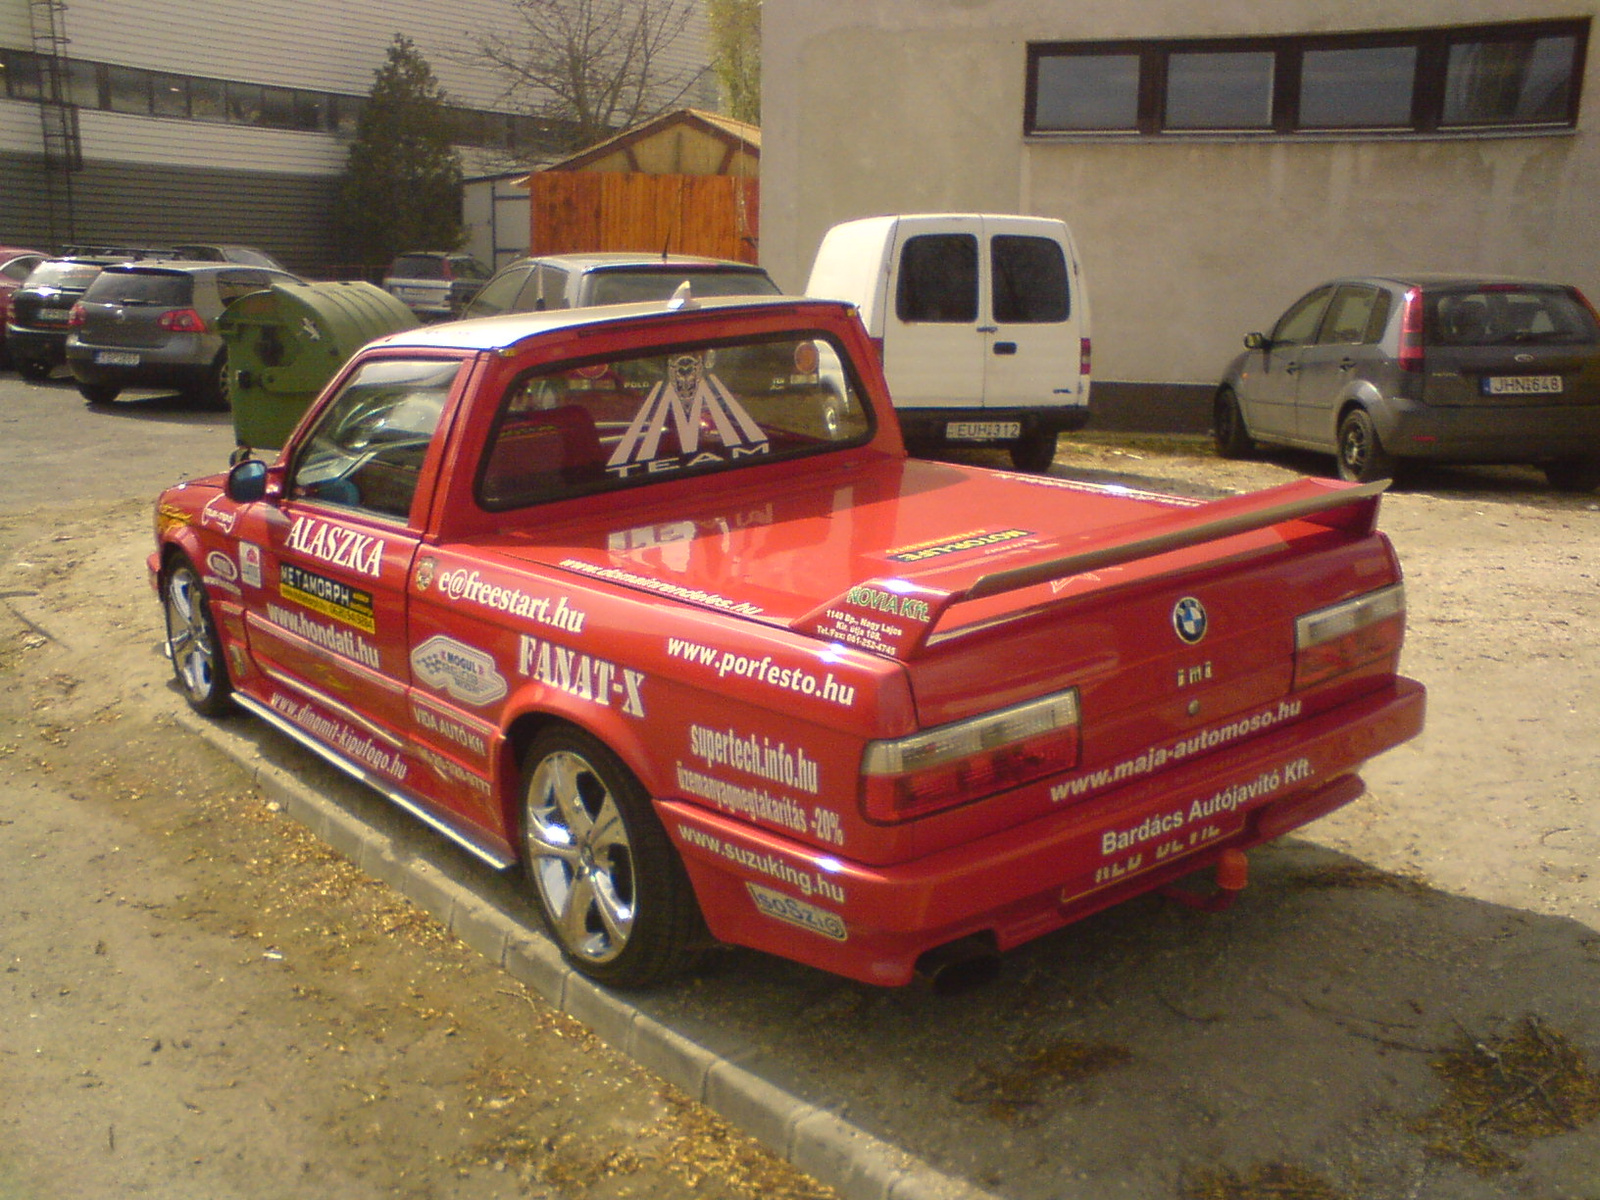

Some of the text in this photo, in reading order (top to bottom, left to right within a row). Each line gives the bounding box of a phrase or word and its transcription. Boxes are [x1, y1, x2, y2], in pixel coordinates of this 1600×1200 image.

[605, 442, 770, 478] TEAM
[284, 516, 385, 578] ALASZKA
[280, 565, 350, 607] METAMORPH
[438, 569, 586, 633] e@freestart.hu
[860, 617, 880, 631] Nagy
[881, 623, 903, 636] Lajos
[518, 633, 645, 718] FANAT-X
[666, 637, 855, 706] www.porfesto.hu
[270, 692, 408, 780] www.dinamit-kipufogo.hu
[690, 723, 819, 794] supertech.info.hu
[1050, 700, 1302, 802] www.maja-automoso.hu
[811, 806, 844, 846] -20%
[1101, 809, 1184, 856] Bardács
[1187, 768, 1280, 824] Autójavító
[1284, 757, 1316, 790] Kft.
[678, 823, 846, 904] www.suzuking.hu
